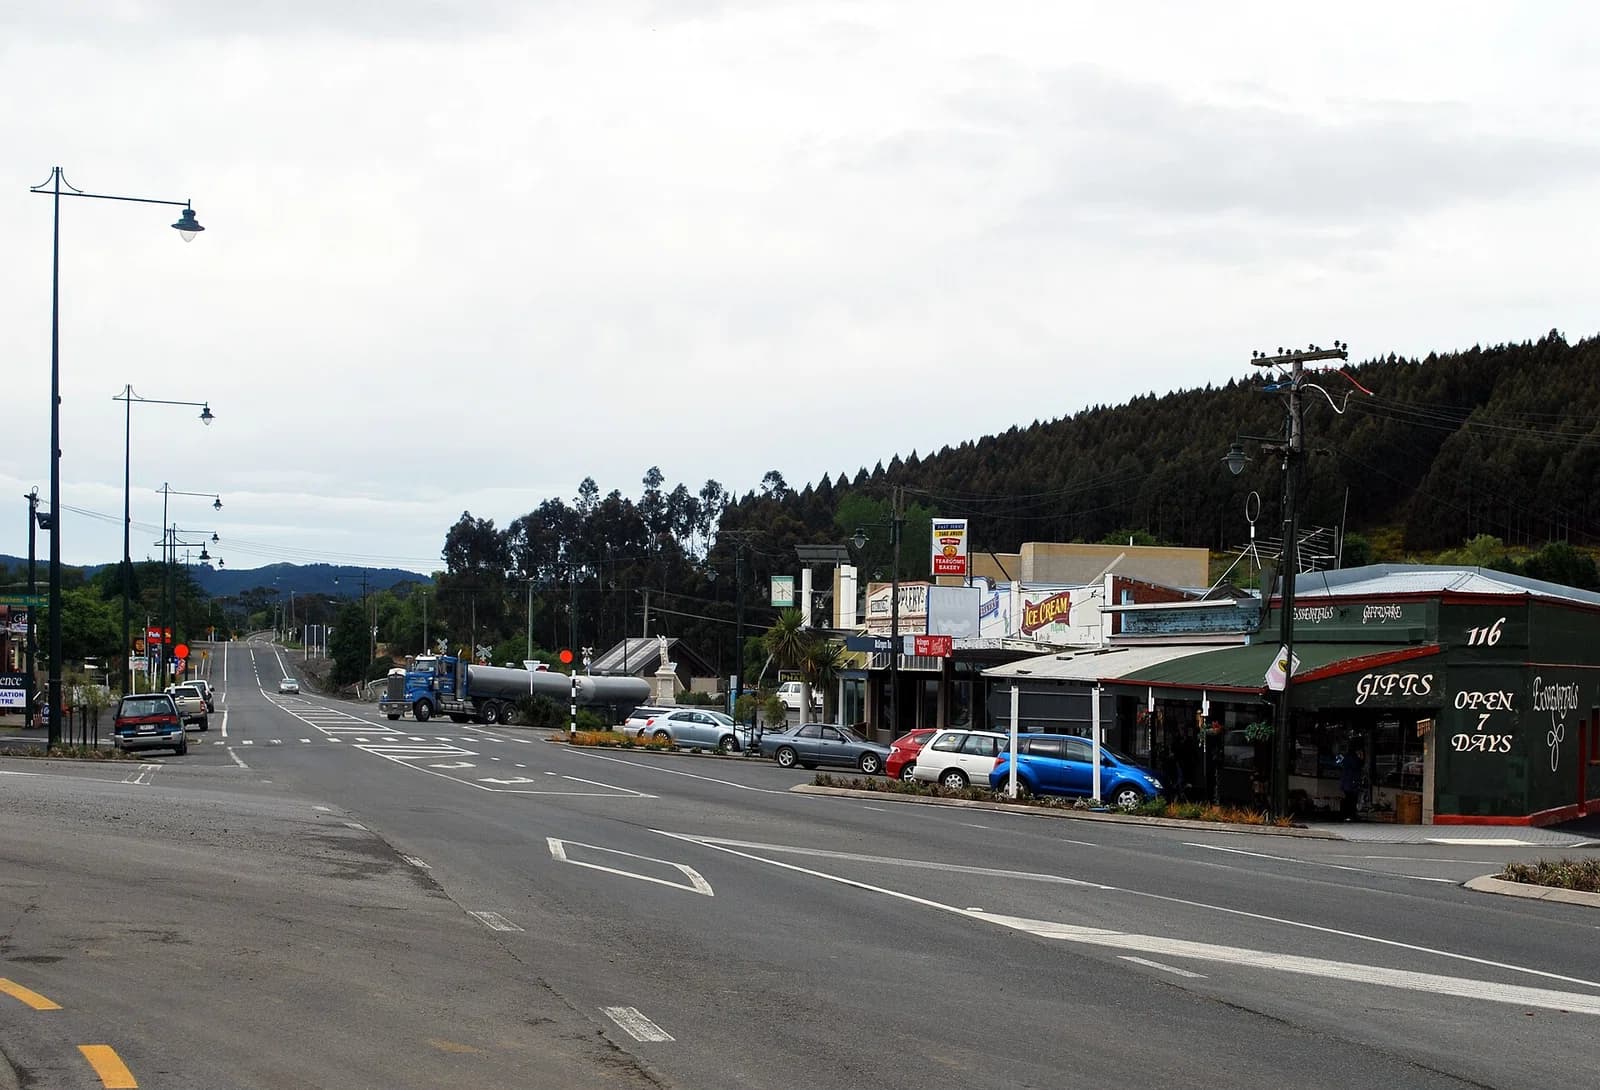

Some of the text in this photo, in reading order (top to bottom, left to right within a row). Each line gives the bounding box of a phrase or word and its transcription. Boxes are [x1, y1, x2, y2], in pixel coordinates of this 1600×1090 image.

[1025, 606, 1039, 626] ICE
[1039, 597, 1068, 624] CREAM
[1465, 617, 1507, 647] 116
[1355, 673, 1434, 705] GIFTS
[1454, 690, 1514, 711] OPEN
[1476, 713, 1491, 731] 7
[1451, 733, 1513, 753] DAYS
